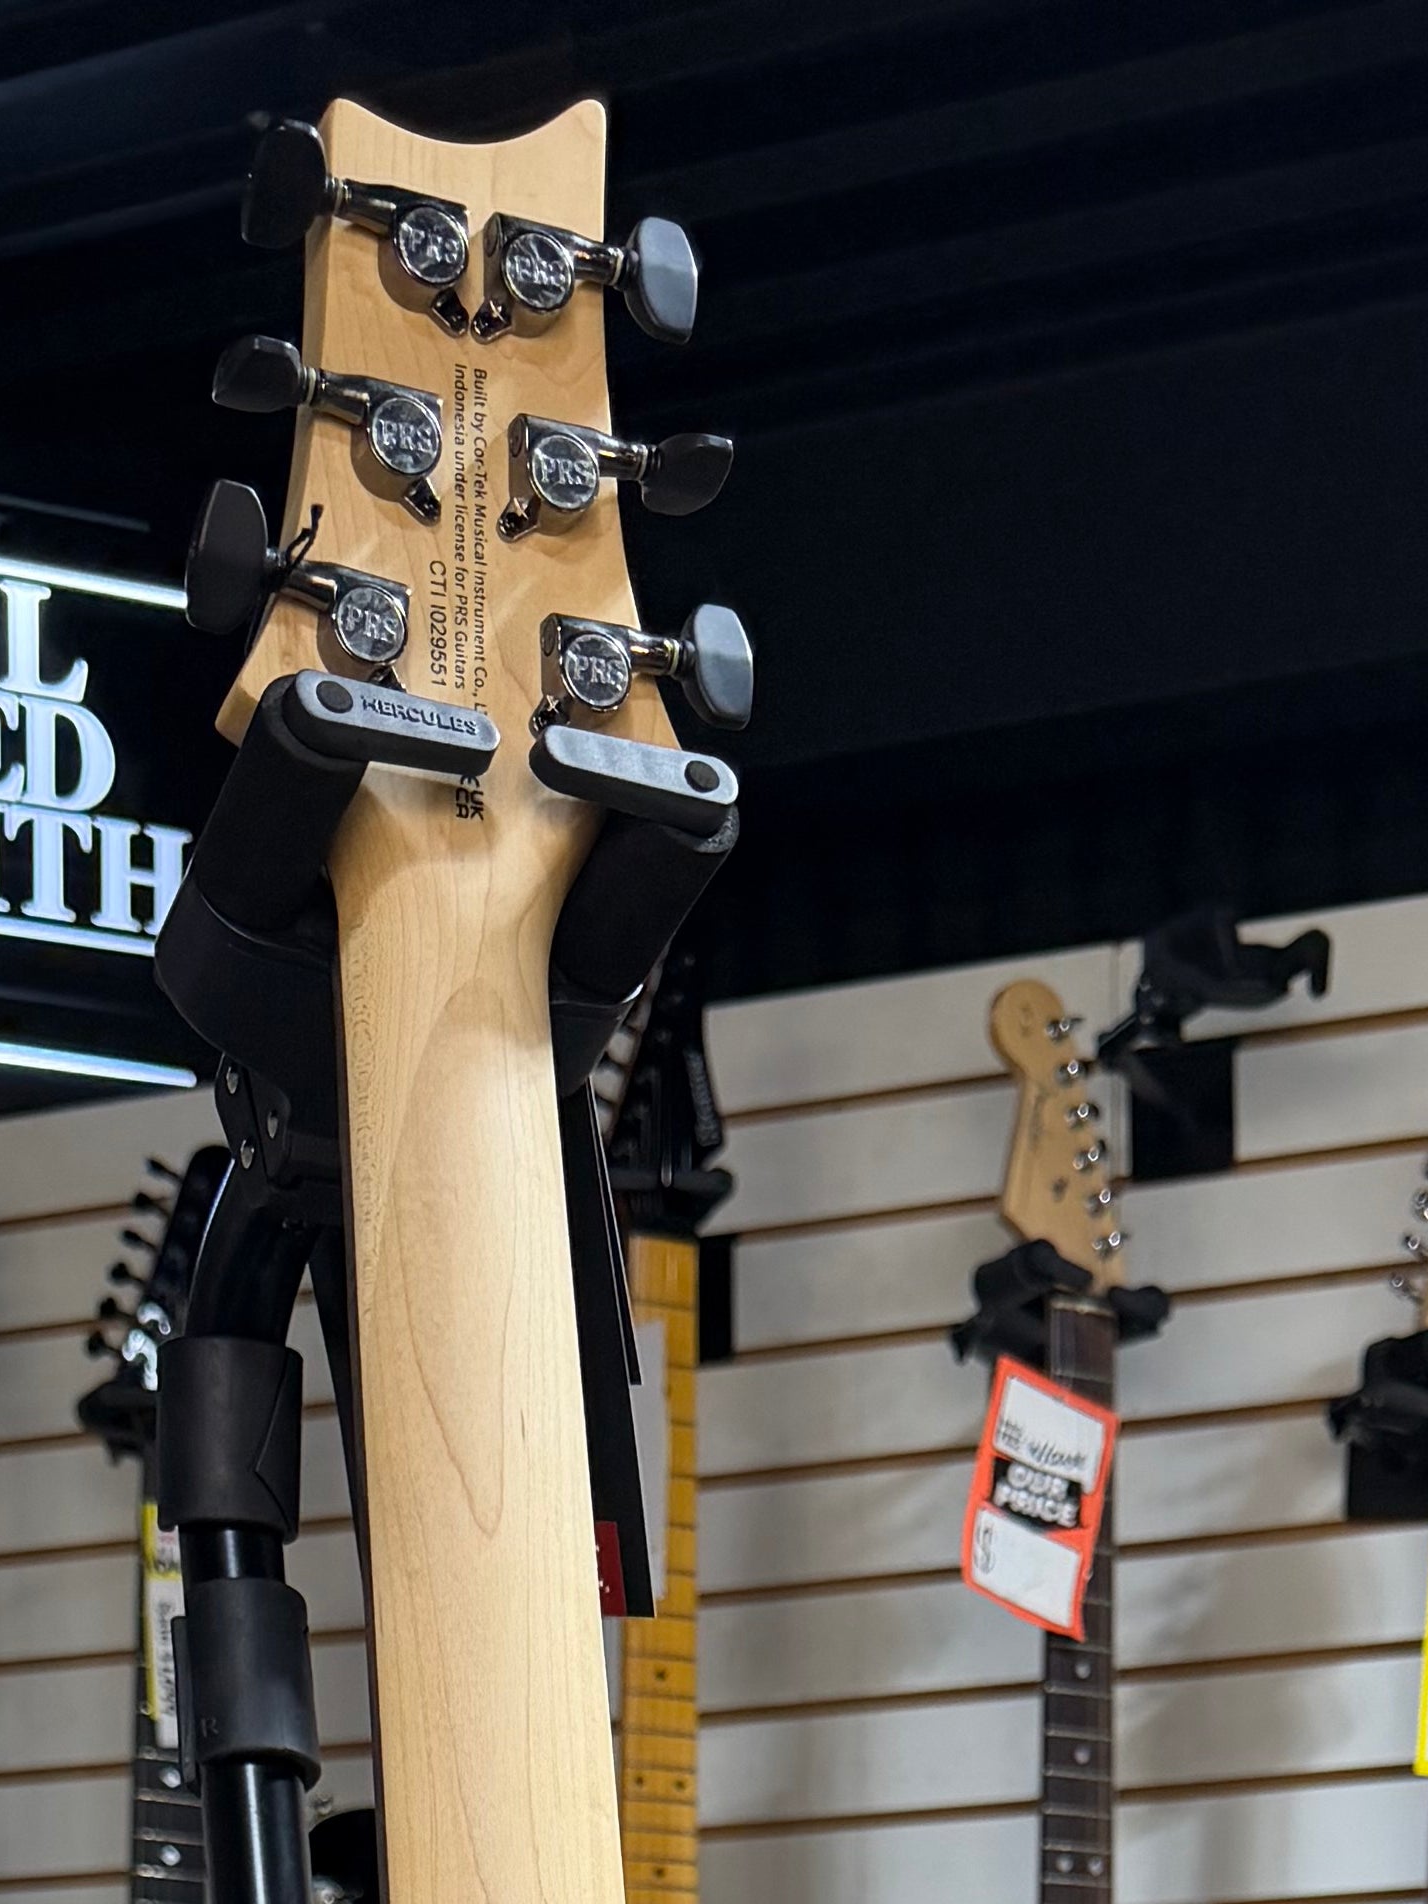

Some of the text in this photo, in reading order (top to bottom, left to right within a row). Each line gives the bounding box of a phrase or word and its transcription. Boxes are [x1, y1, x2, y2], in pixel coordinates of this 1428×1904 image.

[474, 368, 488, 407] Built
[379, 418, 434, 454] PRS
[471, 411, 487, 434] by
[474, 436, 488, 500] Cor-Tek
[538, 453, 595, 487] PRS
[454, 363, 468, 690] Indonesia under license for PRS Guitars
[474, 503, 488, 566] Musical
[343, 603, 399, 642] PRS
[474, 569, 487, 661] Instrument
[472, 667, 488, 697] Co.,
[572, 653, 623, 691] PRS
[360, 694, 478, 736] HERCULES
[1006, 1461, 1069, 1501] OUR
[993, 1481, 1079, 1528] PRICE
